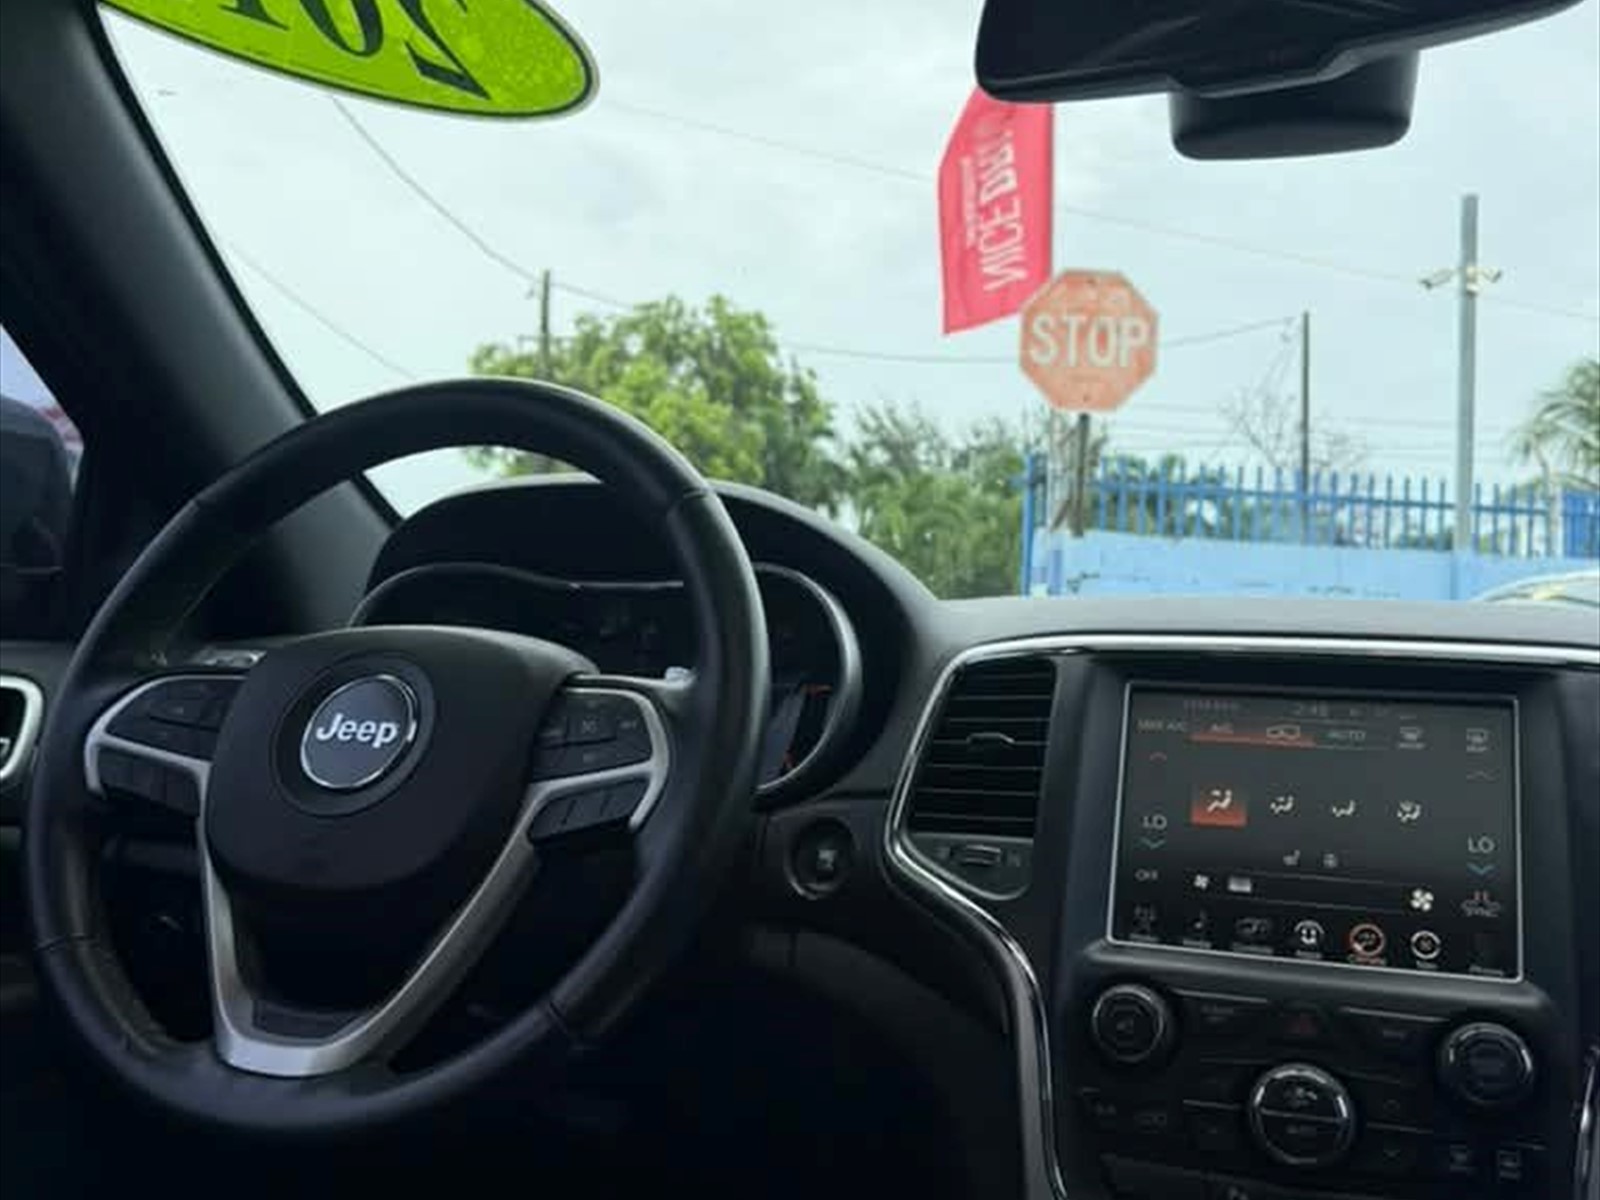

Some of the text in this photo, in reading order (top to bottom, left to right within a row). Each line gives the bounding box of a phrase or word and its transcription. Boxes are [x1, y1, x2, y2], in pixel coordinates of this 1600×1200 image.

[1029, 315, 1149, 367] STOP
[315, 712, 400, 748] Jeep
[1467, 836, 1495, 853] LO
